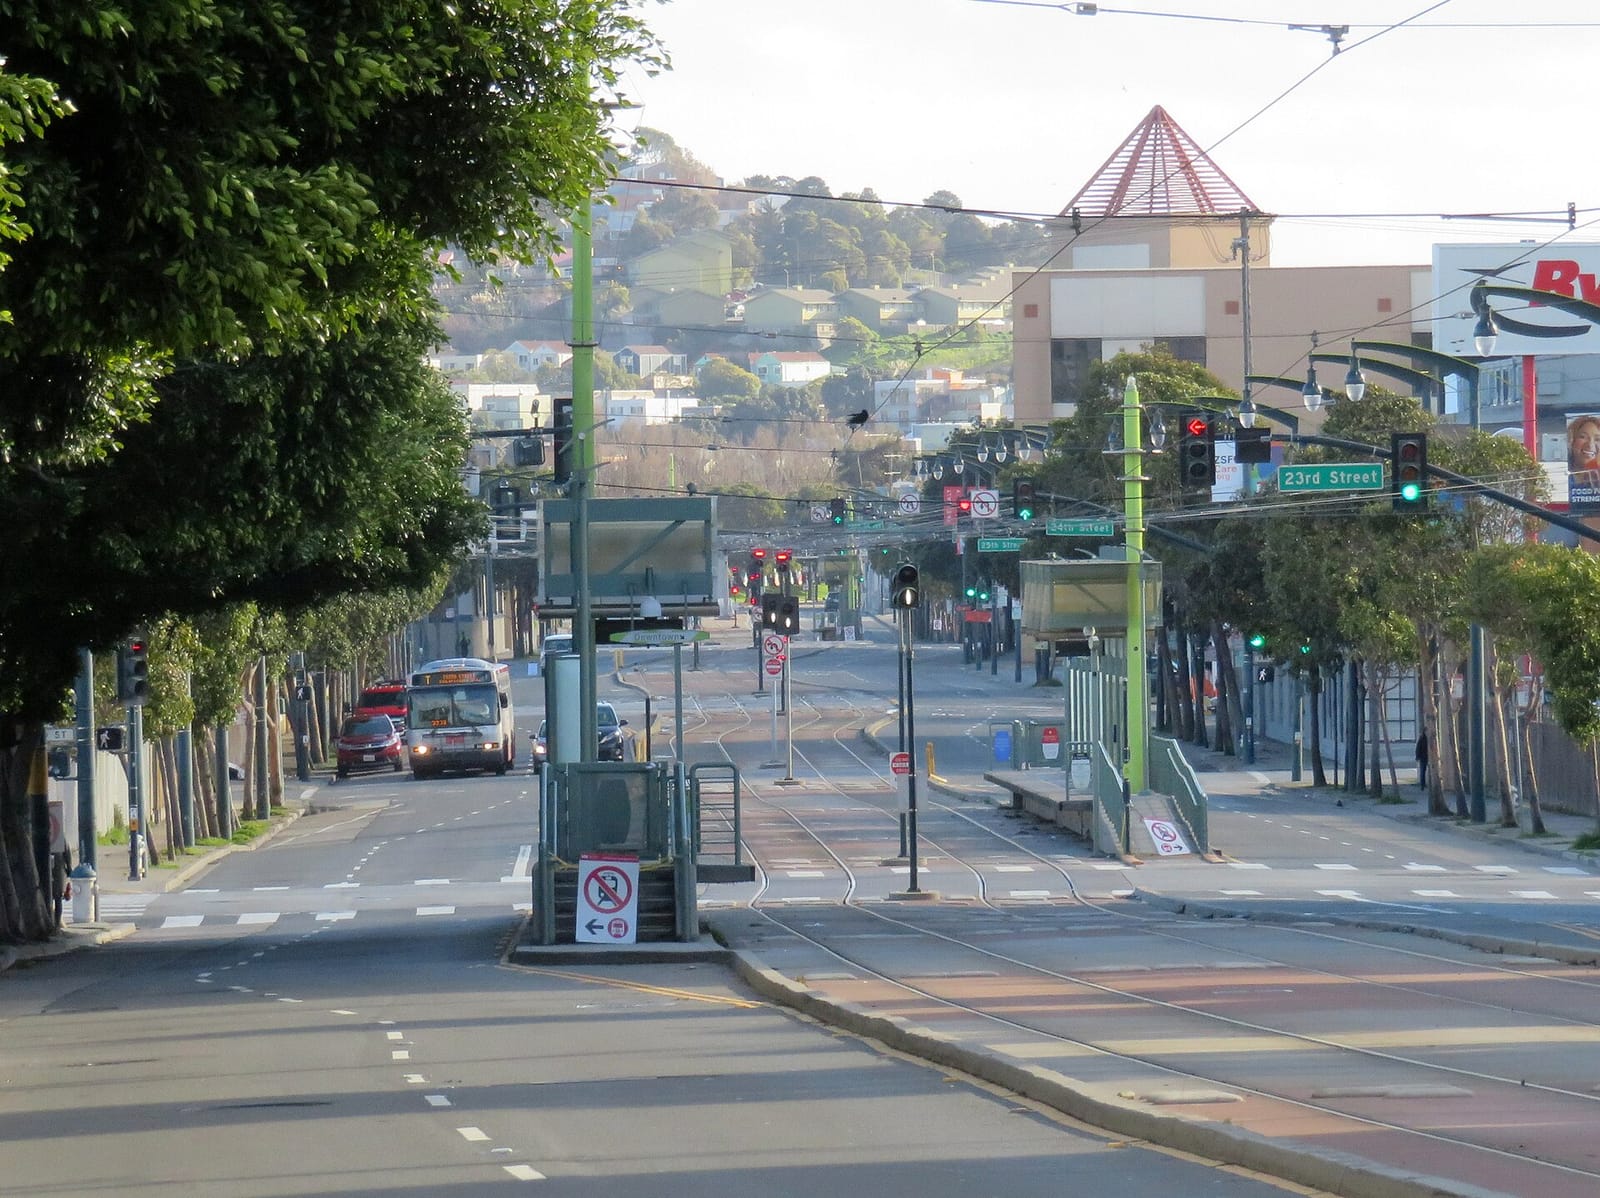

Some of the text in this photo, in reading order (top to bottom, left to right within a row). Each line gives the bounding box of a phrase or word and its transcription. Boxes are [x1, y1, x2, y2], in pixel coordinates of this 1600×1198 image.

[1215, 455, 1236, 464] ZSF
[1285, 470, 1377, 485] 23rd Street
[1050, 522, 1109, 532] 24th Street
[634, 633, 680, 641] Downtown
[424, 674, 431, 686] T
[54, 730, 66, 739] ST
